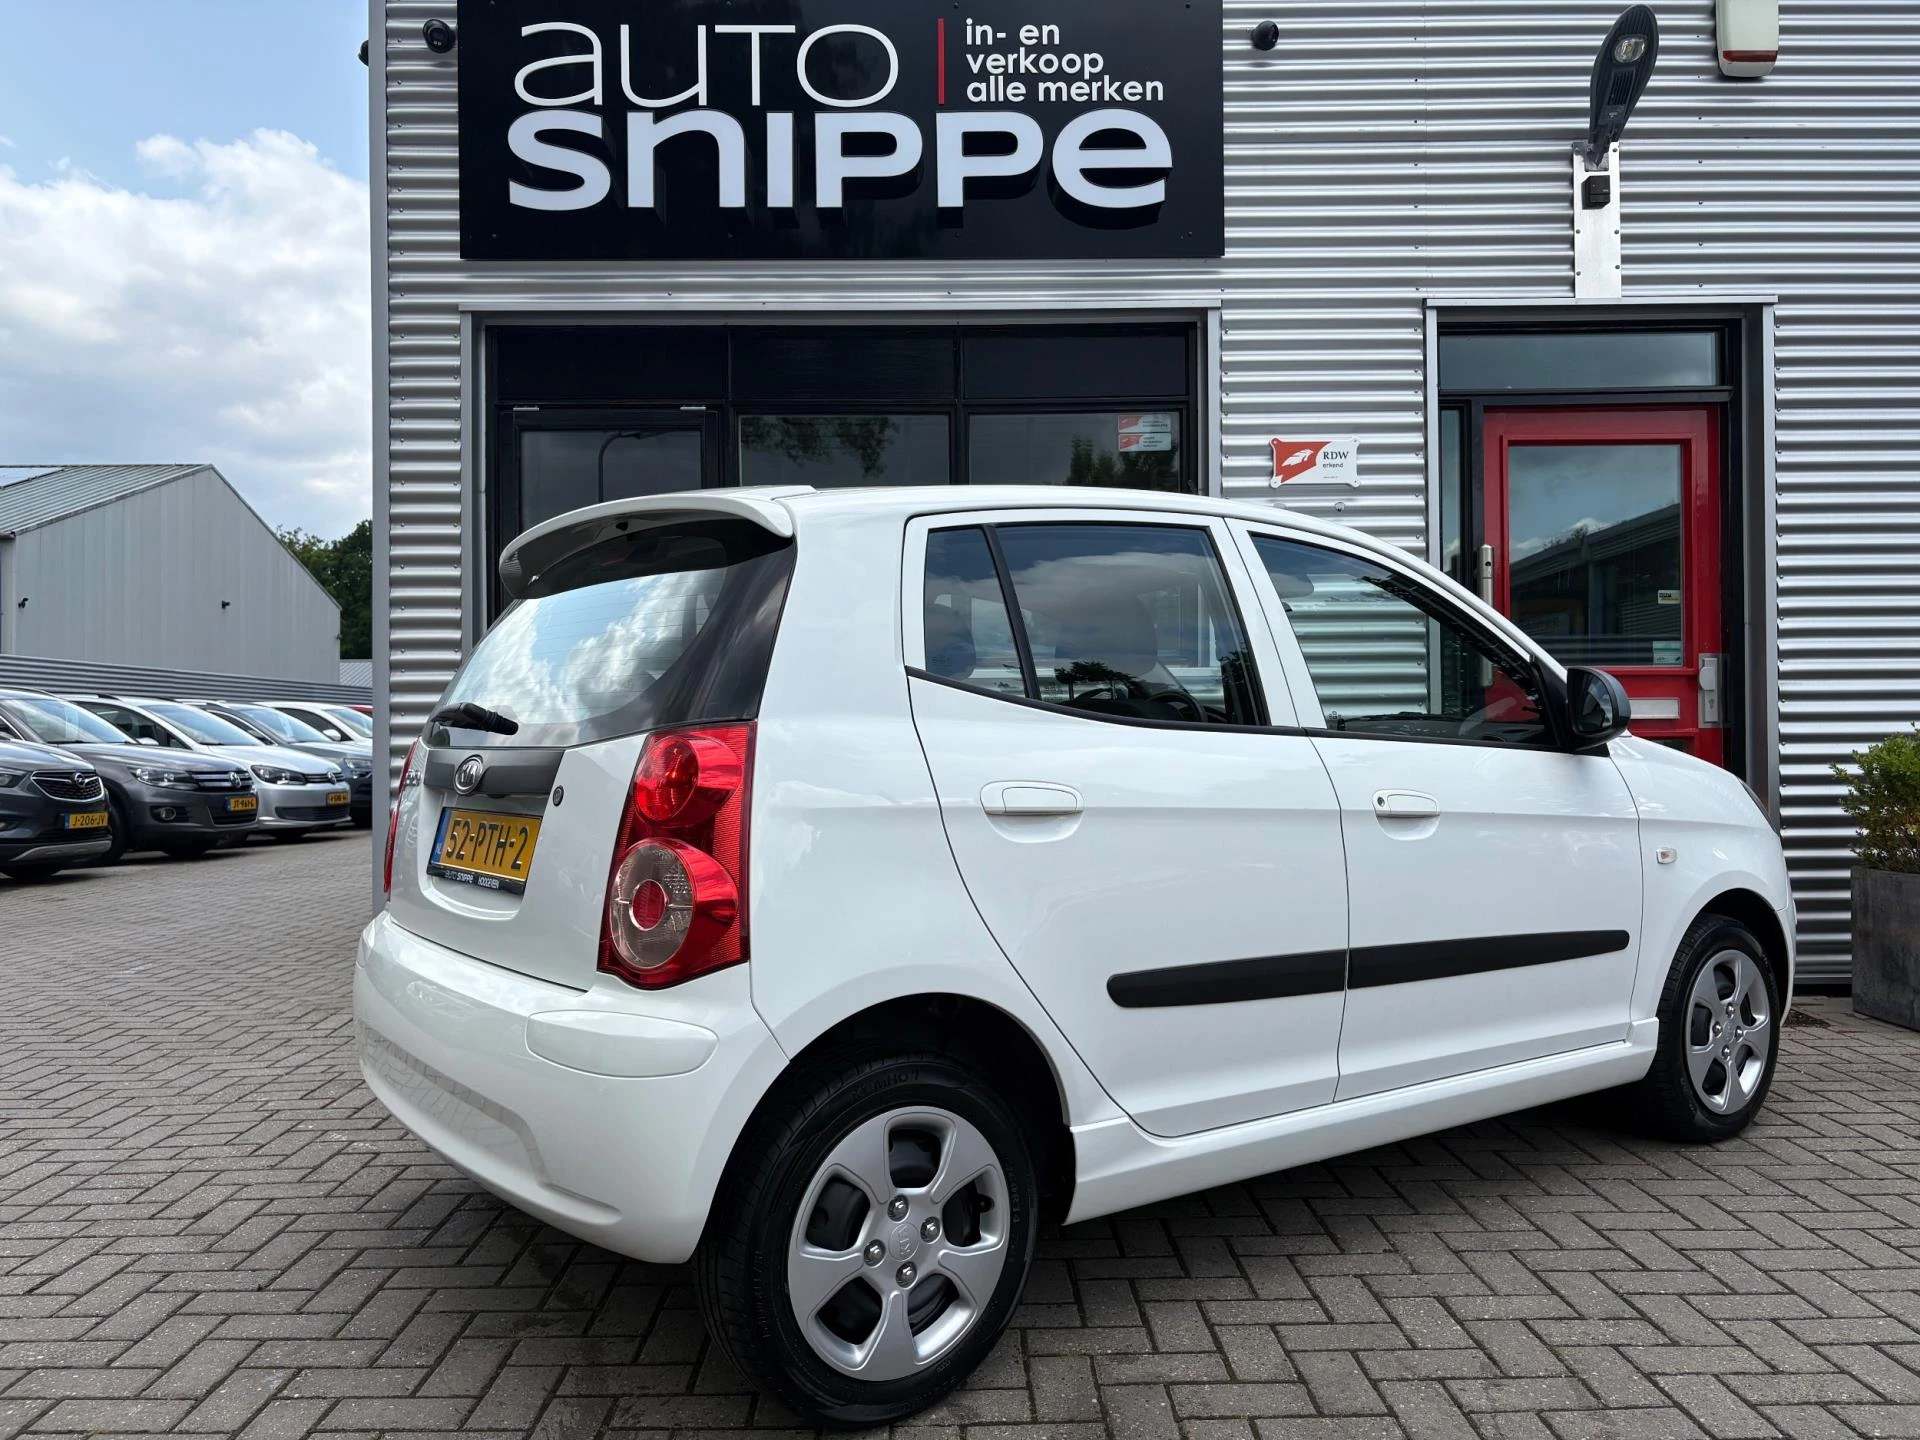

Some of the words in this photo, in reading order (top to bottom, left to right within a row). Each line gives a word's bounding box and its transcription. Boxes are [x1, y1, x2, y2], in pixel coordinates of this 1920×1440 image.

[965, 17, 1007, 45] in-
[1019, 24, 1060, 46] en
[965, 46, 1104, 80] verkoop
[966, 75, 1027, 103] alle
[1038, 74, 1164, 102] merken
[1323, 451, 1349, 460] RDW
[446, 819, 530, 871] 52-PTH-2
